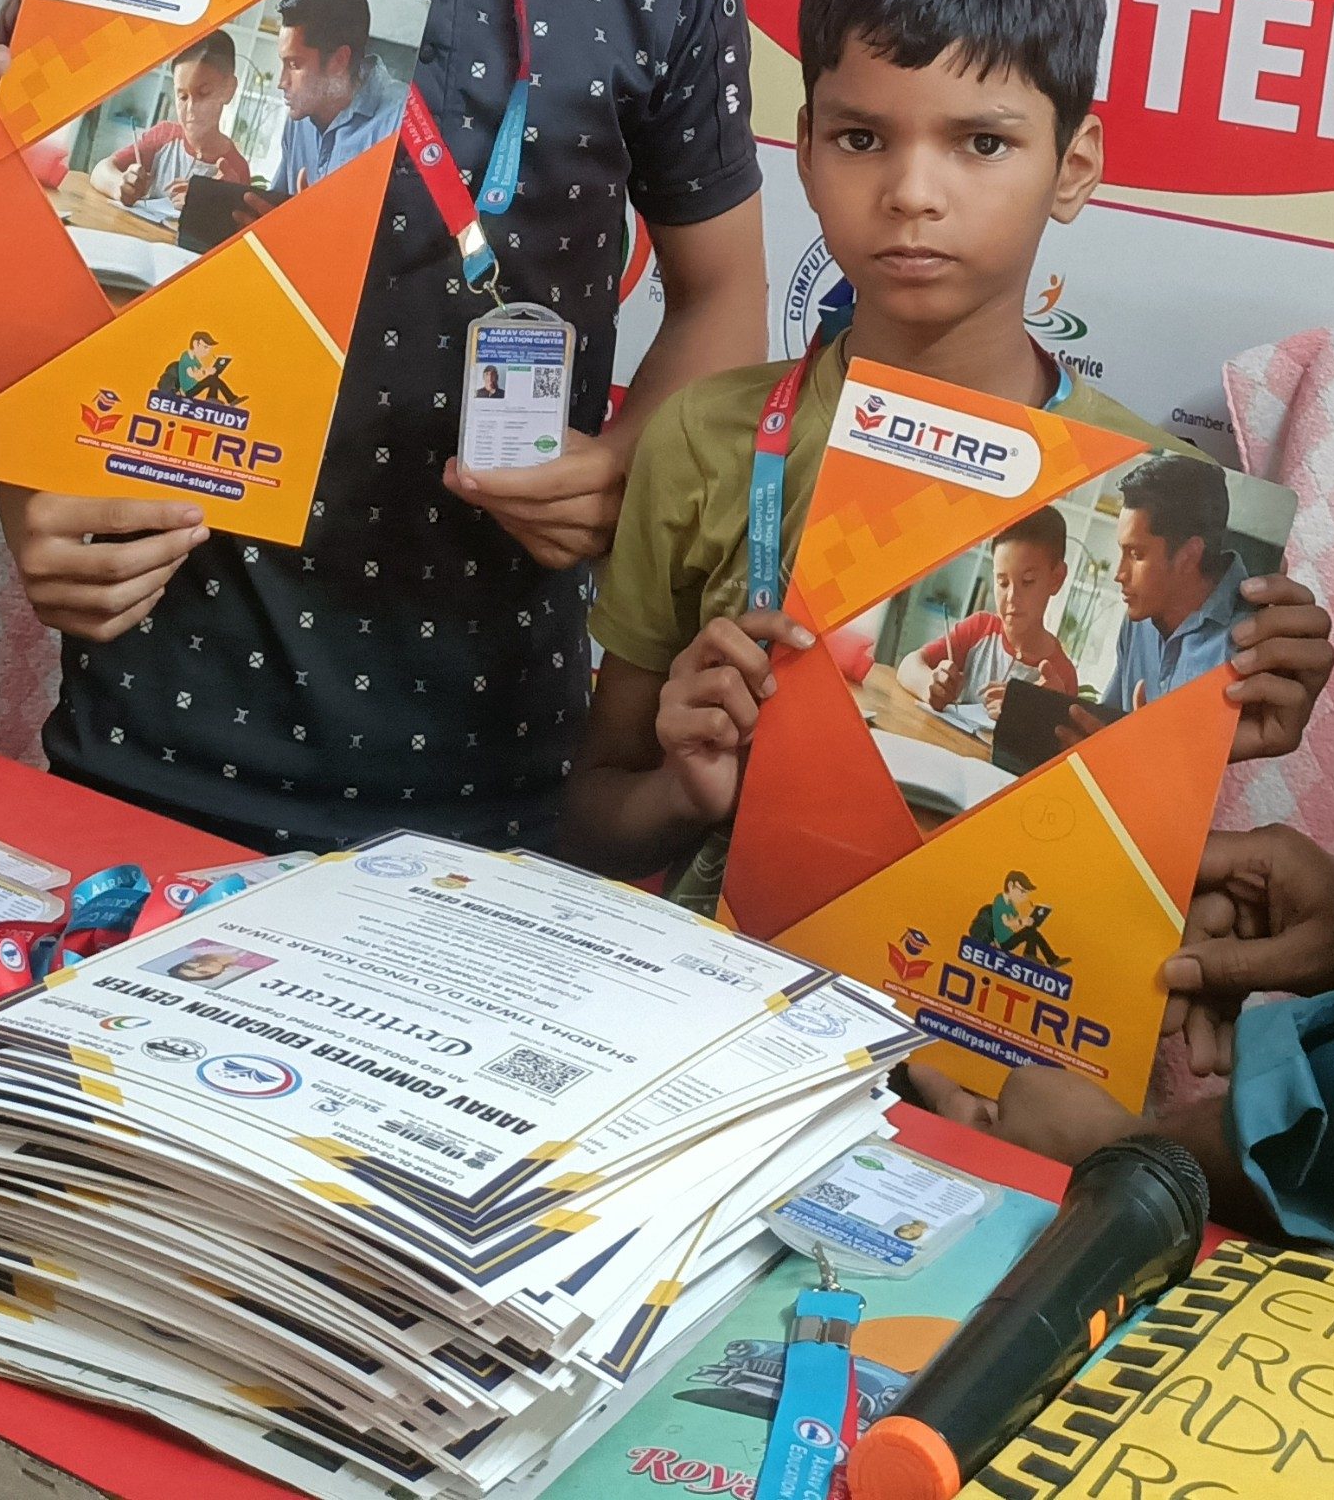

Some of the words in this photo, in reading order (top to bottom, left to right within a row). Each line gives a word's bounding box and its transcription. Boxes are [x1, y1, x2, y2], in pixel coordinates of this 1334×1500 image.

[787, 235, 837, 324] COMPUT
[149, 397, 247, 429] SELF-STUDY
[1171, 406, 1224, 431] Chamber
[109, 459, 242, 496] www.ditrpself-study.com
[752, 487, 763, 541] COMPUTER
[765, 482, 776, 522] CENTER
[752, 542, 762, 579] AARAV
[764, 523, 774, 581] EDUCATION
[406, 886, 463, 904] CENTER
[459, 901, 539, 928] EDUCATION
[214, 920, 289, 943] TIWARI
[534, 925, 616, 955] COMPUTER
[284, 939, 359, 965] KUMAR
[612, 952, 665, 973] AARAV
[354, 960, 424, 985] VINOD
[694, 966, 742, 985] ISO
[961, 944, 1069, 997] SELF-STUDY
[89, 975, 187, 1007] CENTER
[199, 989, 290, 1019] Organization
[420, 981, 468, 999] D/O
[175, 1000, 315, 1049] EDUCATION
[252, 976, 480, 1059] Certificate
[461, 995, 539, 1025] TIWARI
[283, 1015, 348, 1039] Certified
[534, 1022, 641, 1064] SHARDHA
[305, 1042, 450, 1100] COMPUTER
[417, 1062, 447, 1075] ISO
[308, 1082, 348, 1099] India
[345, 1097, 382, 1113] Skill
[442, 1094, 539, 1135] AARAV
